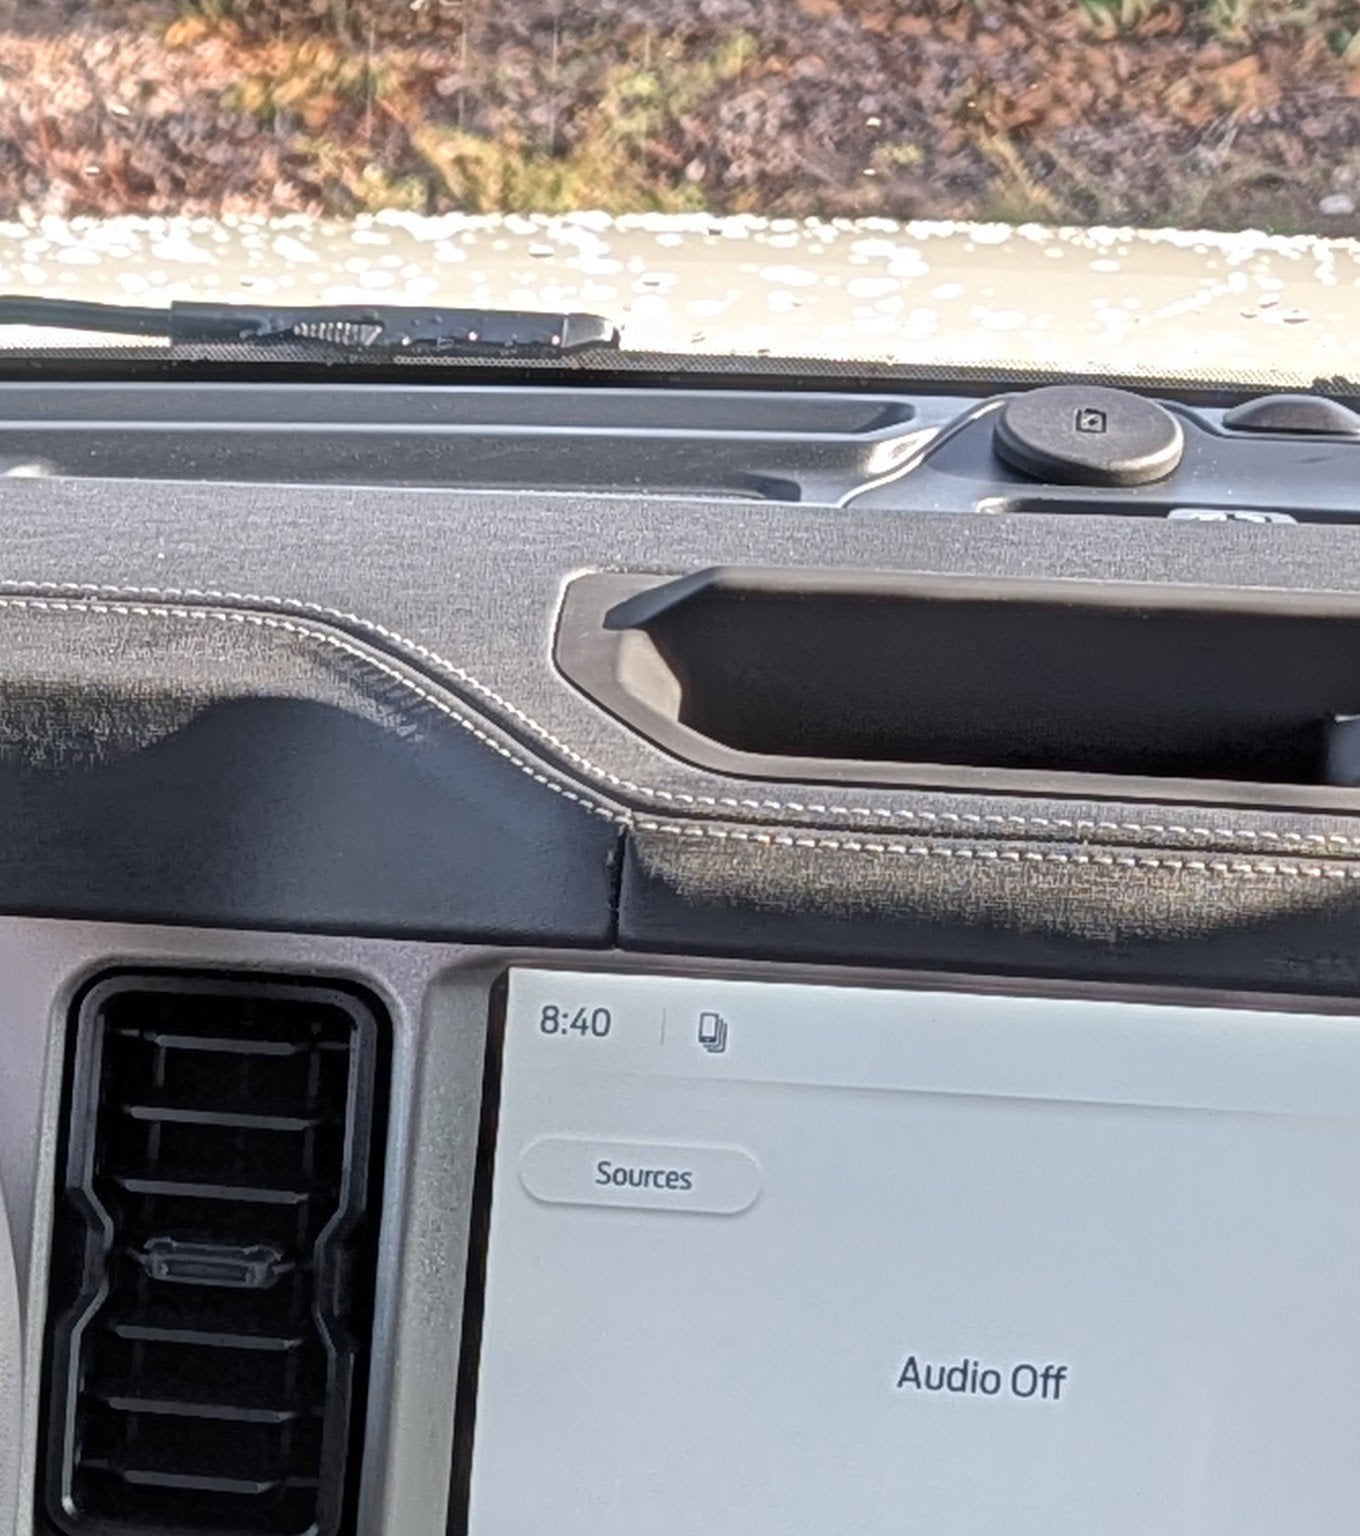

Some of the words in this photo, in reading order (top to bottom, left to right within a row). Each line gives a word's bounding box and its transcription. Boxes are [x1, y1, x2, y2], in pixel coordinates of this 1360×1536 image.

[538, 1004, 613, 1039] 8:40
[595, 1160, 693, 1192] Sources
[896, 1354, 1002, 1396] Audio
[1010, 1362, 1068, 1401] Off
